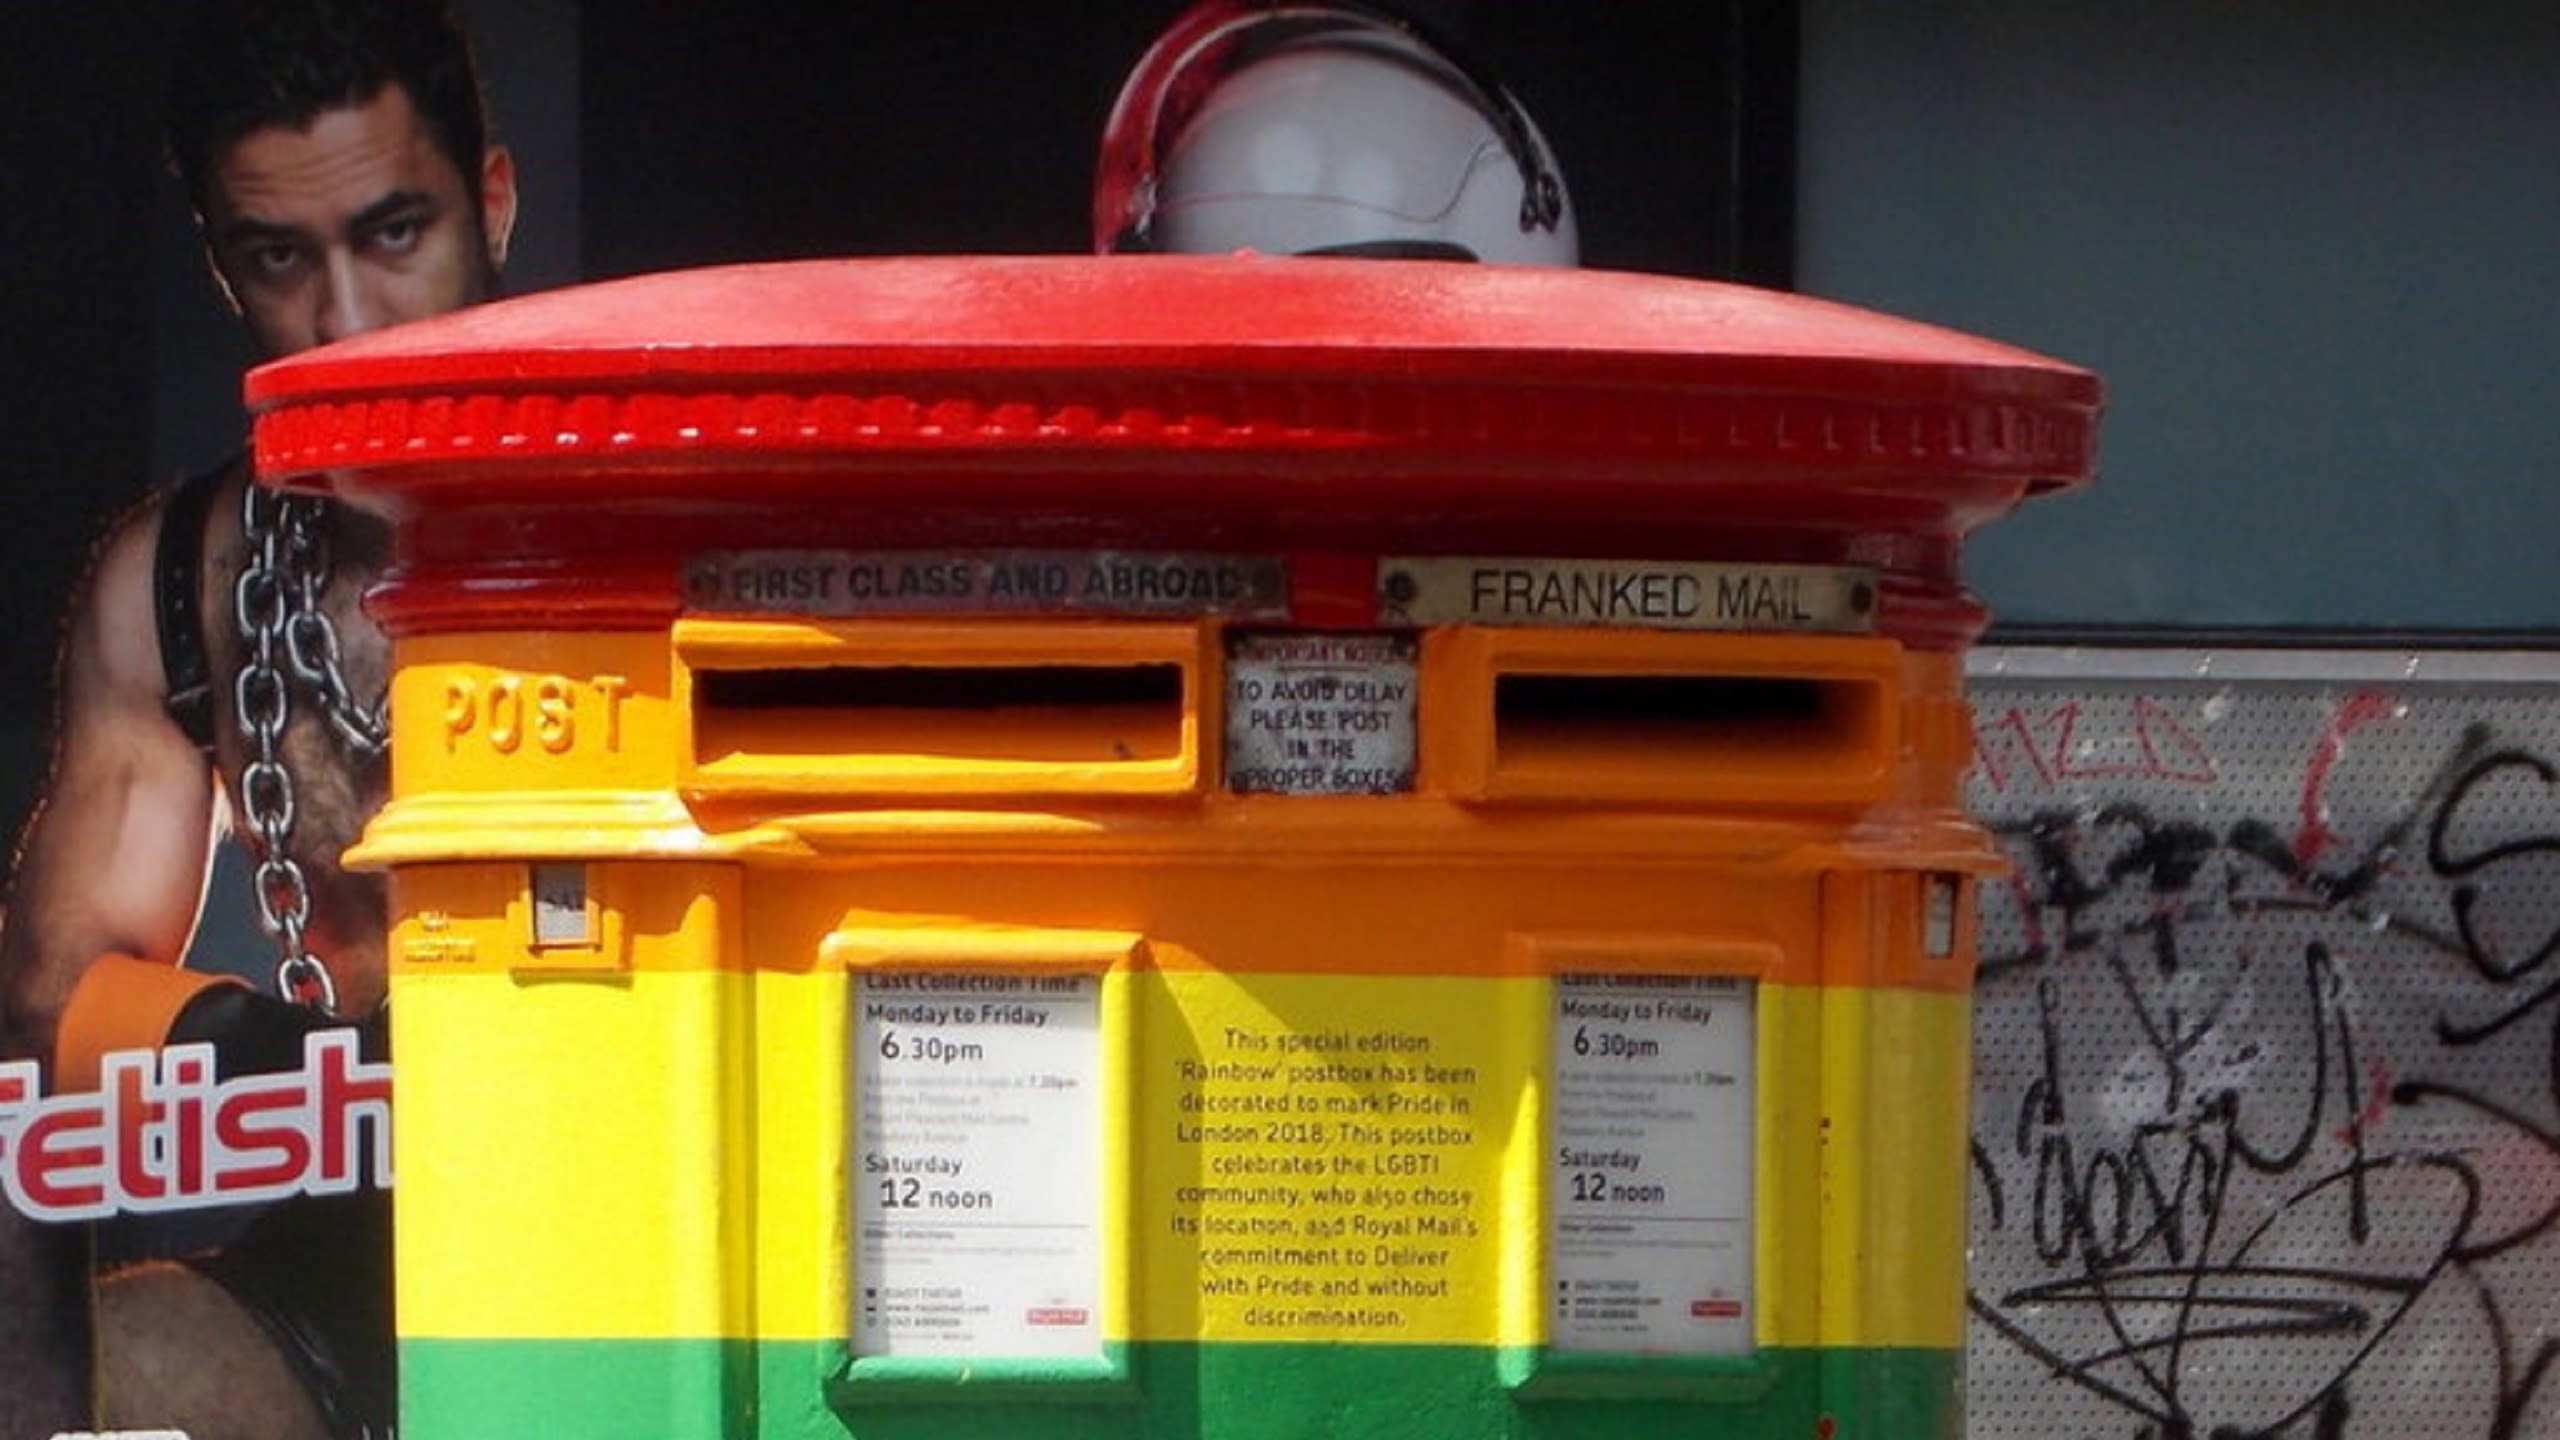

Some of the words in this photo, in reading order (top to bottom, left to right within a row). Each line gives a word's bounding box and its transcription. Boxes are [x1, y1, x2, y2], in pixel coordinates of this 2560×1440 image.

[732, 565, 836, 600] FIRST
[848, 564, 972, 598] CLASS
[991, 564, 1068, 597] AND
[1083, 563, 1238, 599] ABROAD
[1470, 569, 1700, 618] FRANKED
[1716, 575, 1812, 620] MAIL
[1237, 680, 1263, 700] TO
[1271, 679, 1336, 700] AVOID
[1344, 680, 1408, 701] DELAY
[446, 674, 634, 754] POST
[1251, 709, 1326, 730] PLEASE
[1337, 711, 1392, 731] POST
[1287, 738, 1309, 758] IN
[1317, 738, 1356, 760] THE
[1245, 768, 1325, 788] PROPER
[1332, 768, 1398, 789] BOXES
[866, 975, 912, 991] Last
[919, 974, 1023, 992] Collection
[1030, 975, 1081, 992] Time
[866, 1004, 950, 1026] Monday
[953, 1007, 975, 1023] to
[981, 1005, 1049, 1028] Friday
[1560, 1000, 1631, 1023] Monday
[1635, 1004, 1653, 1019] to
[1656, 1001, 1712, 1026] Friday
[880, 1031, 984, 1064] 6.30pm
[1224, 1027, 1269, 1050] This
[1277, 1028, 1349, 1054] special
[1357, 1030, 1430, 1051] edition
[1573, 1025, 1660, 1060] 6.30pm
[1287, 1060, 1373, 1084] postbox
[1381, 1061, 1418, 1083] has
[1424, 1061, 1478, 1084] been
[1178, 1093, 1290, 1114] decorated
[1296, 1095, 1319, 1114] to
[1325, 1093, 1380, 1114] mark
[1386, 1093, 1444, 1115] Pride
[1450, 1095, 1470, 1114] in
[1176, 1123, 1259, 1144] London
[1338, 1123, 1384, 1145] This
[1390, 1124, 1471, 1148] postbox
[865, 1153, 963, 1177] Saturday
[1211, 1154, 1327, 1175] celebrates
[1332, 1155, 1367, 1175] the
[1374, 1155, 1440, 1176] LGBTI
[1560, 1147, 1640, 1172] Saturday
[880, 1177, 921, 1209] 12
[928, 1190, 993, 1209] noon
[1175, 1186, 1306, 1209] community,
[1311, 1186, 1357, 1206] who
[1363, 1186, 1408, 1207] also
[1411, 1187, 1472, 1207] chose
[1571, 1172, 1607, 1202] 12
[1611, 1184, 1665, 1203] noon
[1171, 1216, 1199, 1234] its
[1204, 1216, 1300, 1237] location,
[1304, 1216, 1345, 1236] and
[1352, 1215, 1411, 1239] Royal
[1416, 1216, 1478, 1237] Mail's
[1201, 1247, 1339, 1266] commitment
[1345, 1248, 1368, 1266] to
[1373, 1246, 1449, 1267] Deliver
[1201, 1277, 1249, 1296] with
[1256, 1277, 1314, 1297] Pride
[1319, 1277, 1360, 1297] and
[1366, 1278, 1449, 1297] without
[1244, 1308, 1407, 1327] discrimination.
